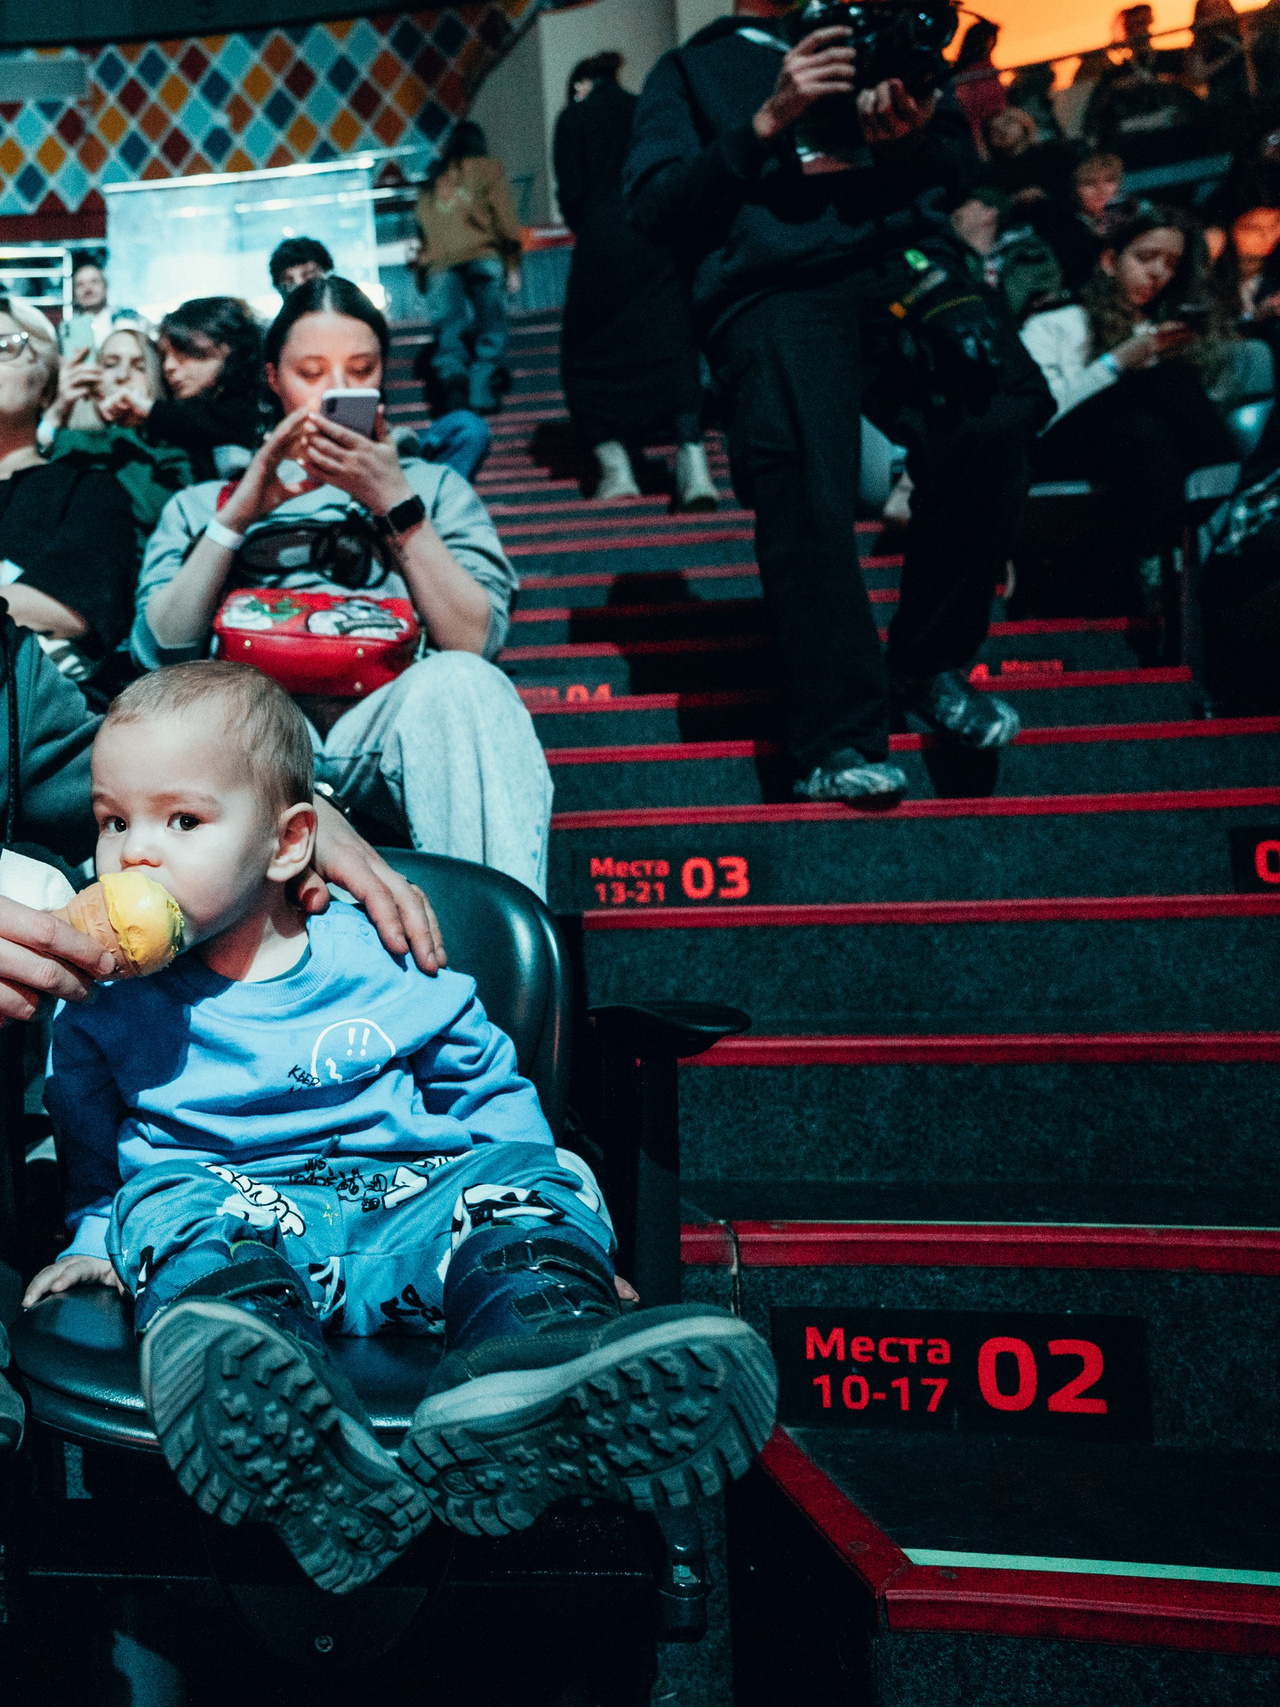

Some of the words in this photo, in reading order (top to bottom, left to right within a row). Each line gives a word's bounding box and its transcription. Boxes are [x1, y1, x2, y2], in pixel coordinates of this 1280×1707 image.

[589, 856, 670, 878] Места
[681, 856, 750, 900] 03
[594, 880, 666, 904] 13-21
[804, 1326, 952, 1365] Места
[812, 1374, 949, 1413] 10-17
[977, 1336, 1108, 1415] 02
